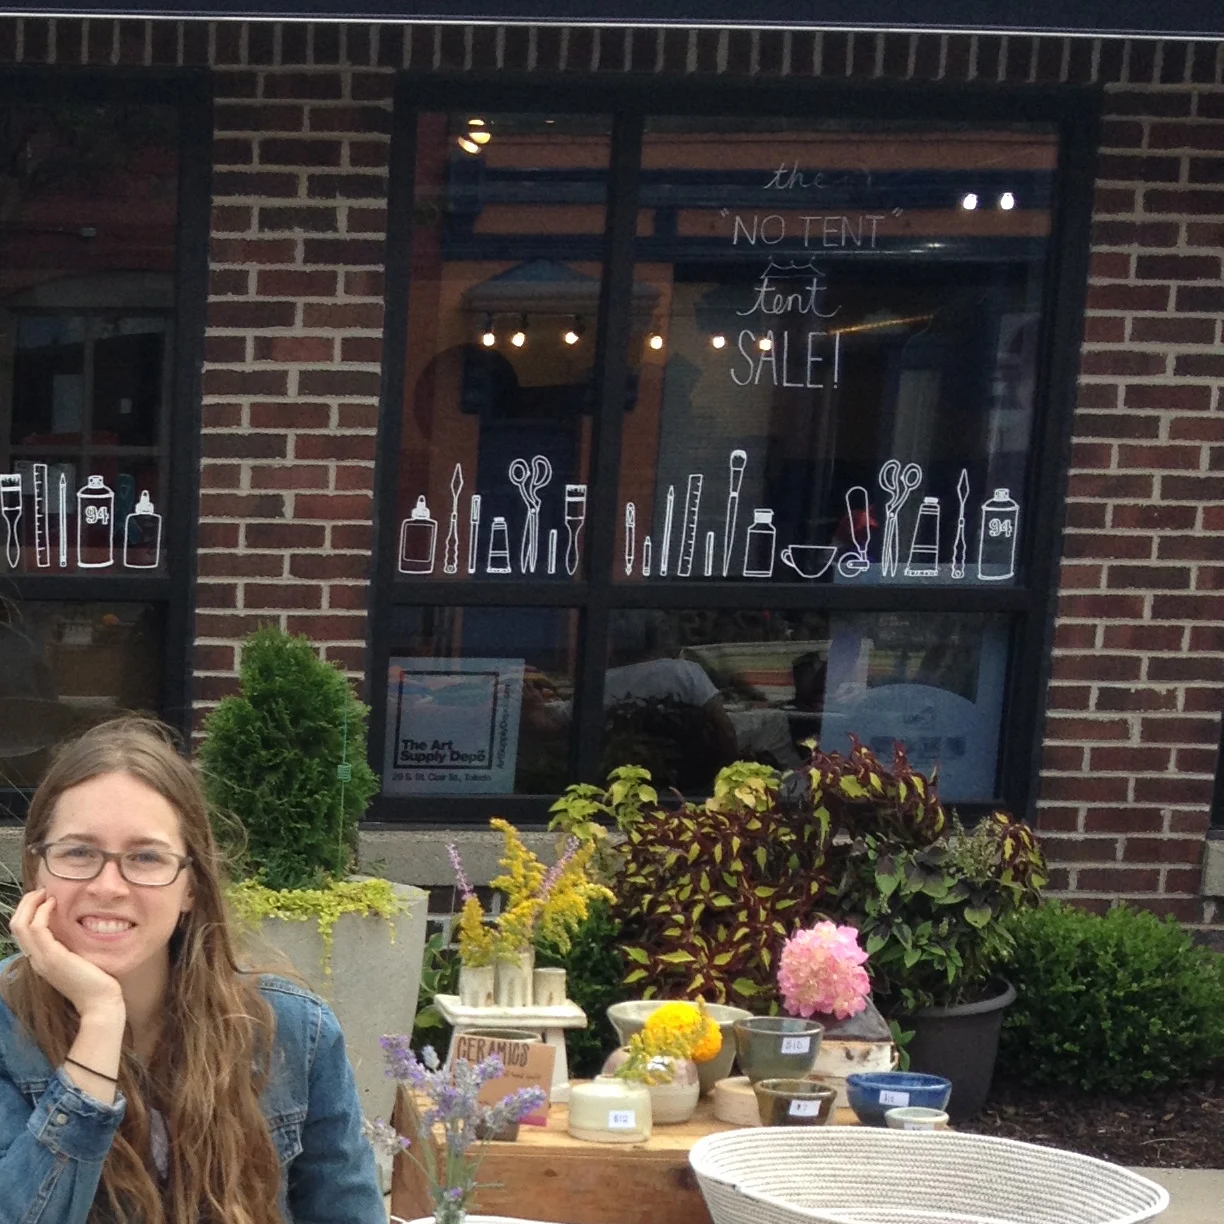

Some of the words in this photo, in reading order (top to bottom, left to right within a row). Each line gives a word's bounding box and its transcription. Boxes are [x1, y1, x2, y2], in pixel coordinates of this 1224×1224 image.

[736, 277, 842, 318] tent
[731, 329, 841, 389] SALE!
[84, 505, 109, 525] 94
[988, 517, 1013, 539] 94
[401, 739, 427, 751] The
[431, 739, 453, 751] Art
[400, 751, 447, 764] Supply
